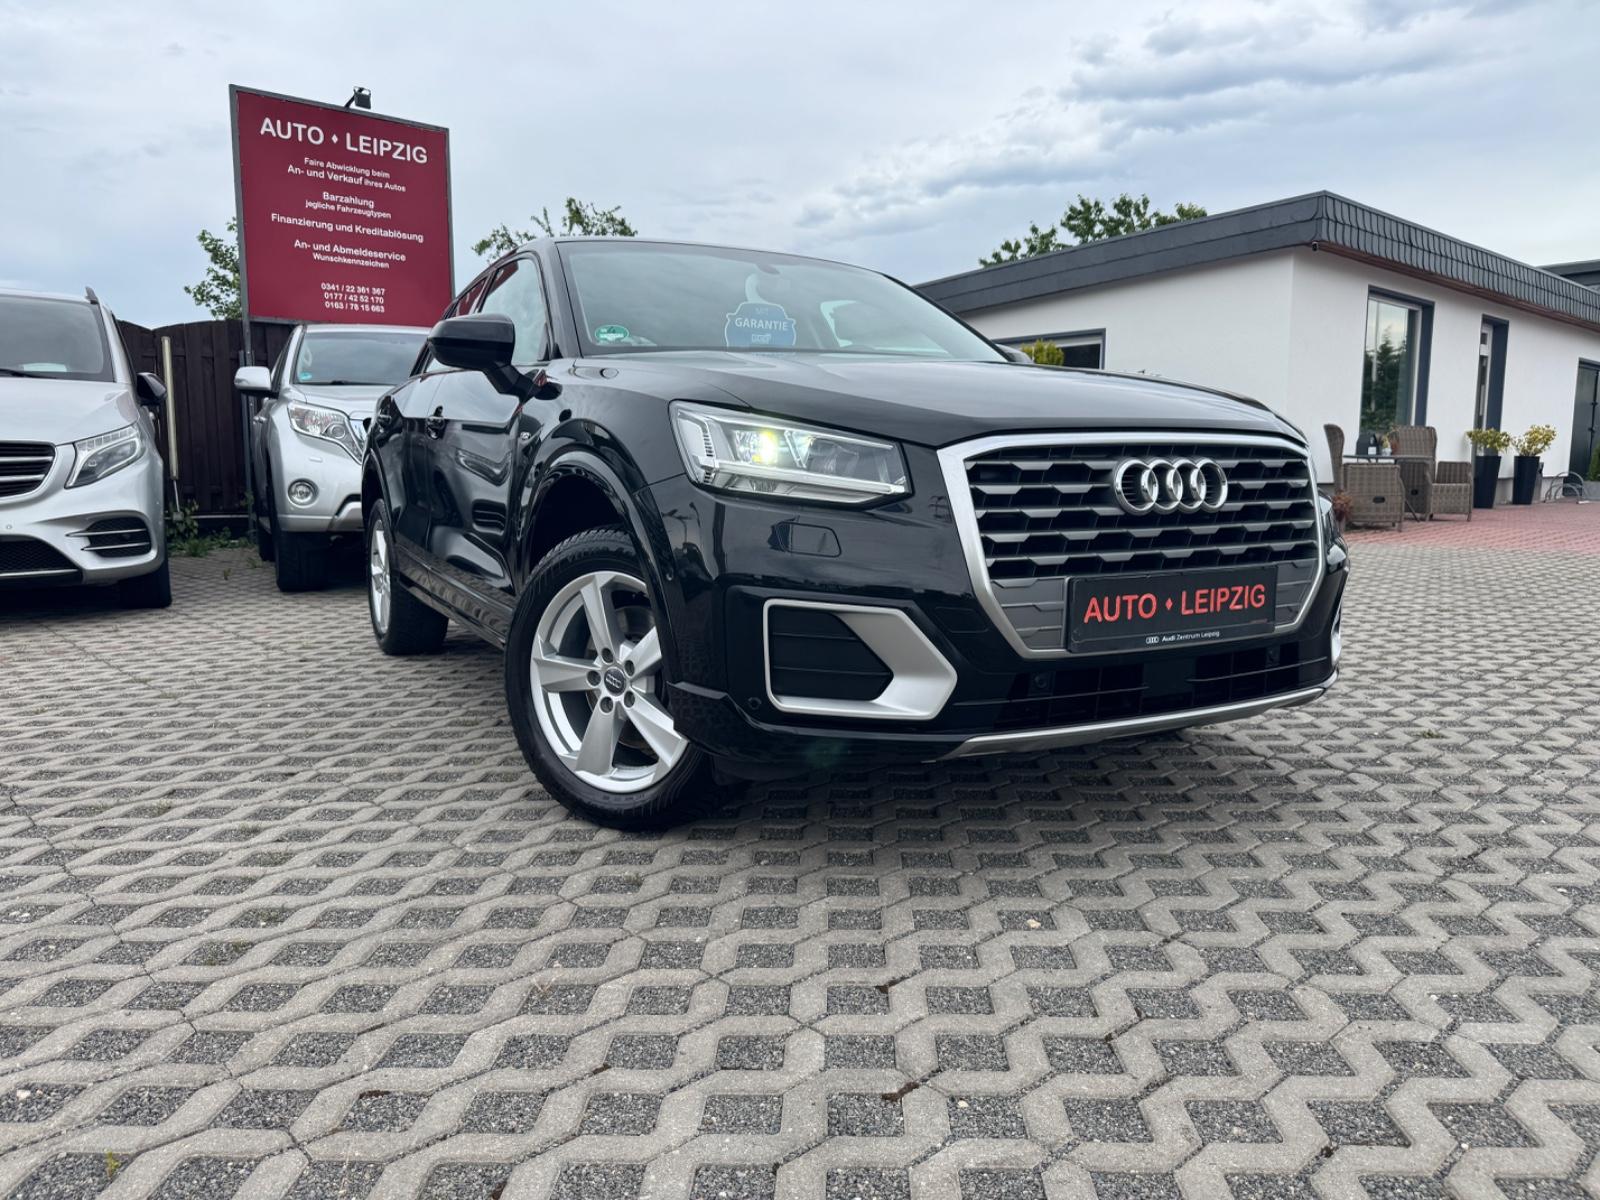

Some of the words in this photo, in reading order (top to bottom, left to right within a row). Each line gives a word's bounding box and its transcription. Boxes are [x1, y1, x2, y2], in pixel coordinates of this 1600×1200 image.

[260, 116, 324, 145] AUTO
[346, 132, 428, 164] LEIPZIG
[304, 158, 324, 167] Faire
[326, 161, 370, 176] Abwicklung
[372, 169, 390, 178] beim
[288, 164, 304, 174] An-
[306, 169, 324, 178] und
[326, 171, 362, 185] Verkauf
[384, 182, 406, 192] Autos
[322, 191, 374, 208] Barzahlung
[305, 200, 335, 211] jegliche
[336, 204, 392, 219] Fahrzeugtypen
[271, 213, 333, 232] Finanzierung
[336, 224, 352, 232] und
[294, 240, 310, 249] An-
[312, 243, 330, 252] und
[332, 244, 406, 261] Abmeldeservice
[313, 252, 389, 268] Wunschkennzeichen
[735, 318, 789, 331] GARANTIE
[1083, 592, 1158, 624] AUTO
[1181, 584, 1265, 616] LEIPZIG
